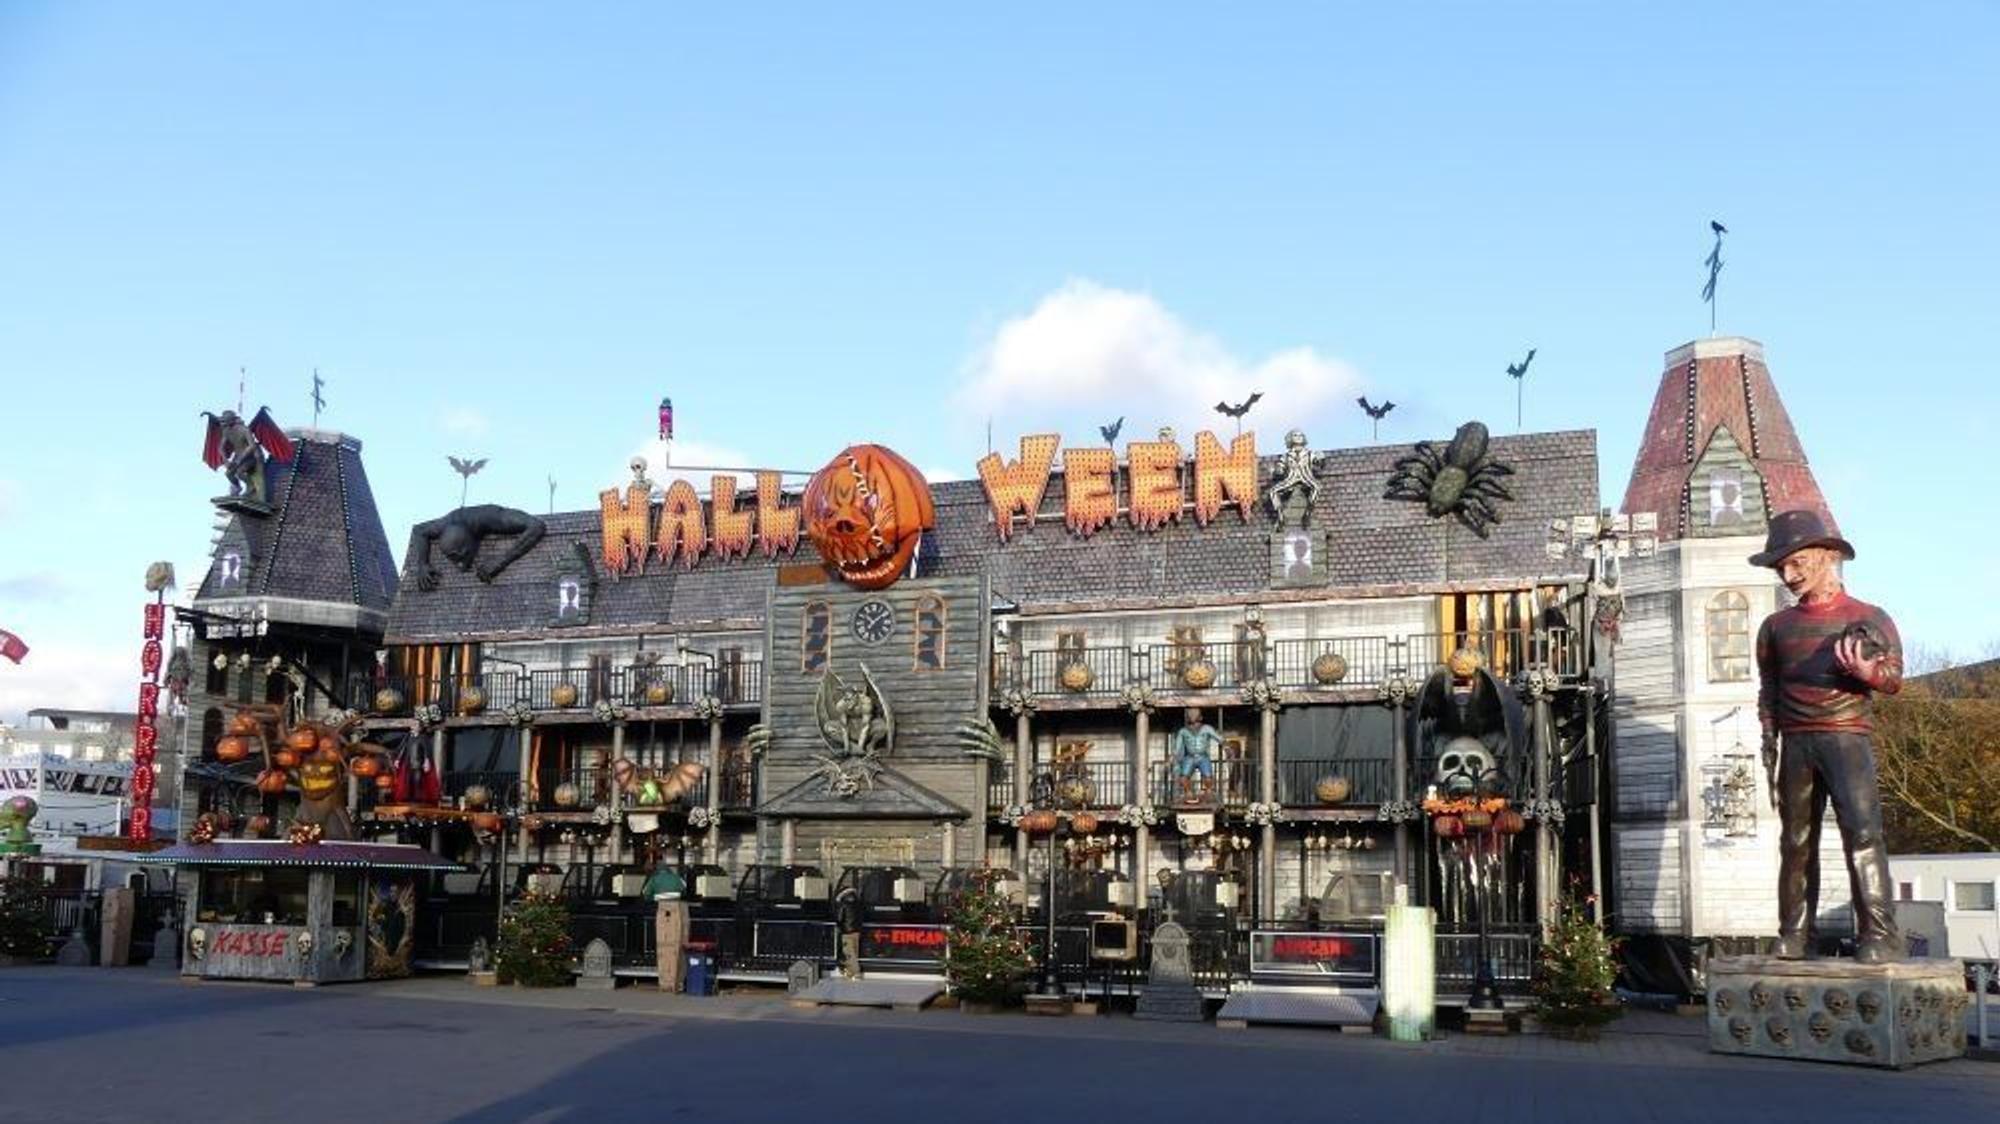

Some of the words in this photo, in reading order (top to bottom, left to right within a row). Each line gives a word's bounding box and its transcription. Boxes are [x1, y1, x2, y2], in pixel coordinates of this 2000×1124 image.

[600, 470, 802, 583] HALL
[977, 430, 1258, 545] WEEN
[129, 603, 165, 842] HORROR
[212, 929, 289, 957] KASSE
[892, 929, 946, 945] EINGAN
